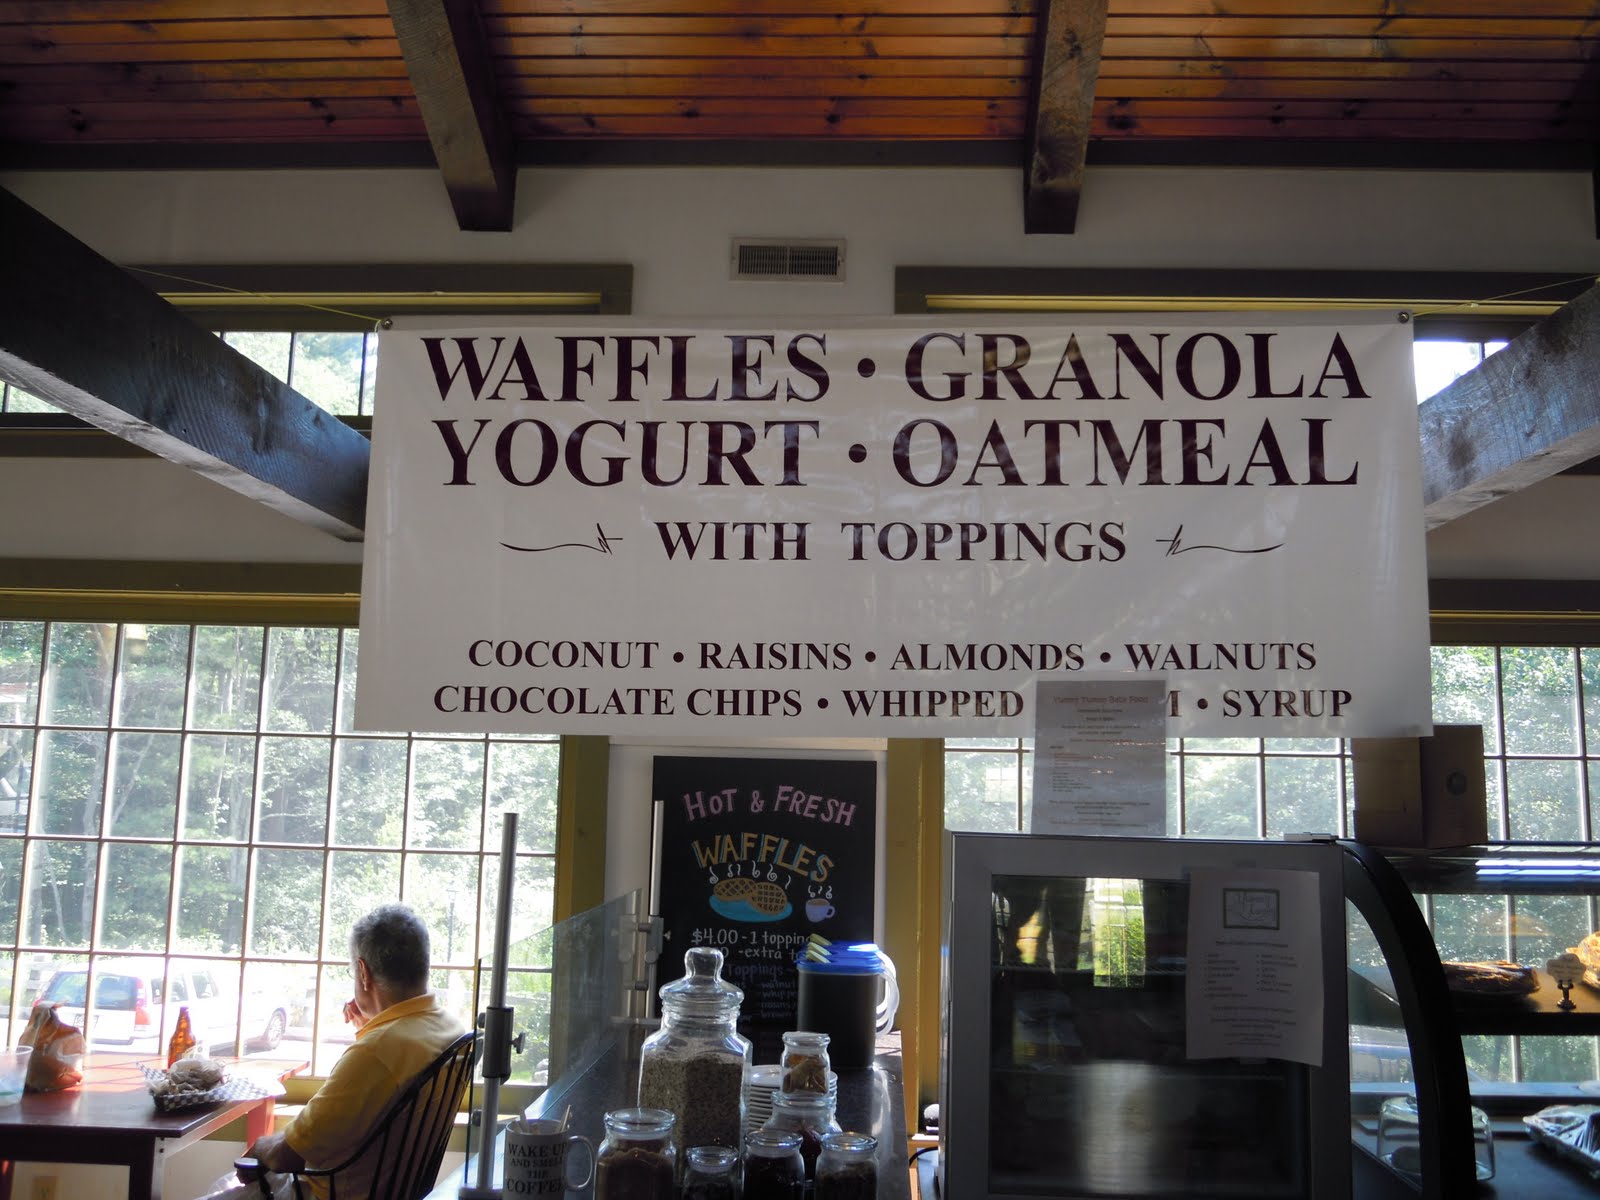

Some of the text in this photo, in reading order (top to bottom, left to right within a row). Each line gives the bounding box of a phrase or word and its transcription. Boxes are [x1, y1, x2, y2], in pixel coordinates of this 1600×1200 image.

[421, 332, 1371, 402] WAFFLES GRANOLA
[432, 417, 1359, 487] YOGURT OATMEAL
[654, 521, 1126, 562] WITH TOPPINGS
[468, 640, 1316, 671] COCONUT RAISINS ALMONDS WALNUTS
[434, 685, 1352, 718] CHOCOLATE CHIPS WHIPPED SYRUP
[751, 790, 765, 813] &
[774, 785, 857, 826] FRESH
[691, 832, 835, 883] WAFFLES
[691, 928, 738, 945] $4.00
[508, 1141, 567, 1158] WAKE UP
[511, 1158, 530, 1168] AND
